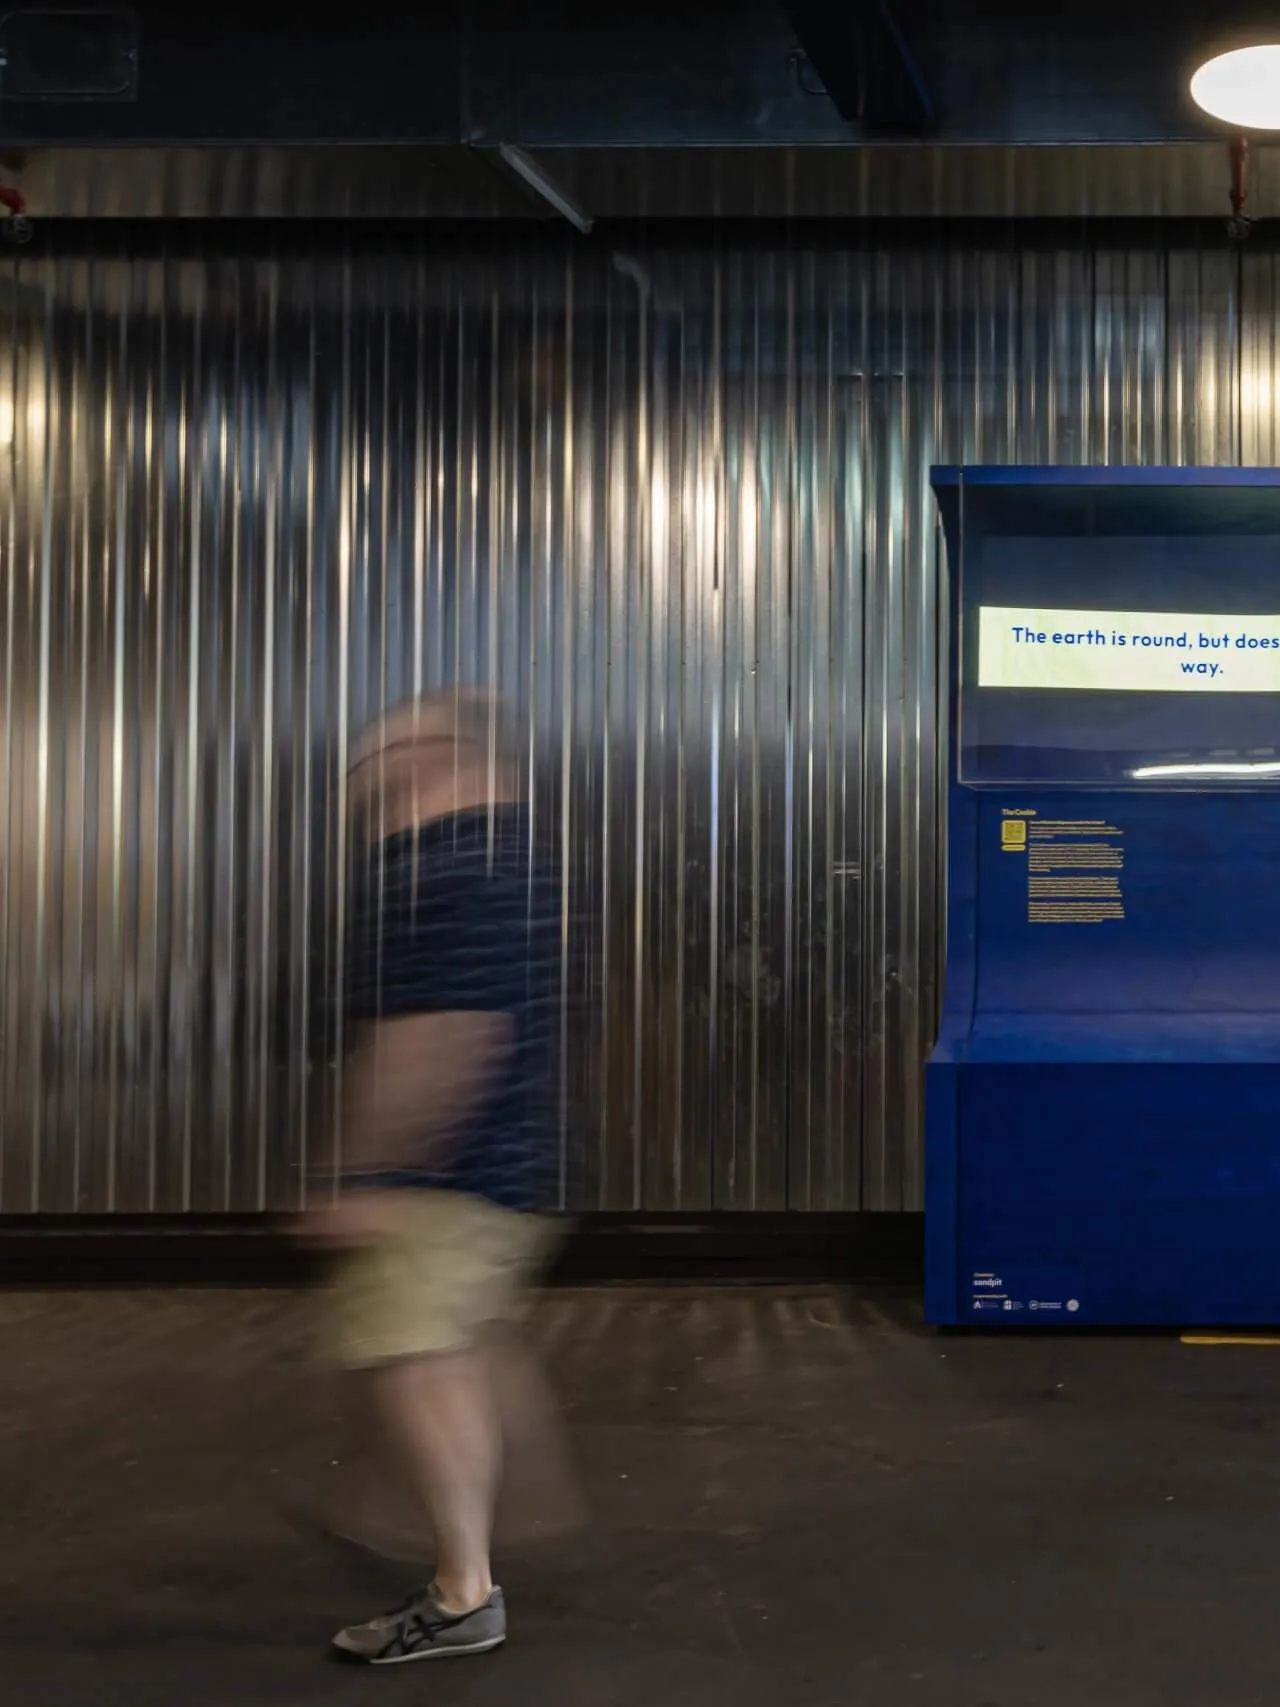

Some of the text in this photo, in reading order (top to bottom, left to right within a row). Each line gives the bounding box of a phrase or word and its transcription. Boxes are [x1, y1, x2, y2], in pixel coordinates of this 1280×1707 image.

[1011, 626, 1047, 644] The
[1051, 629, 1106, 645] earth
[1111, 630, 1127, 646] is
[1132, 631, 1193, 650] round,
[1198, 632, 1230, 649] but
[1180, 663, 1224, 678] way.
